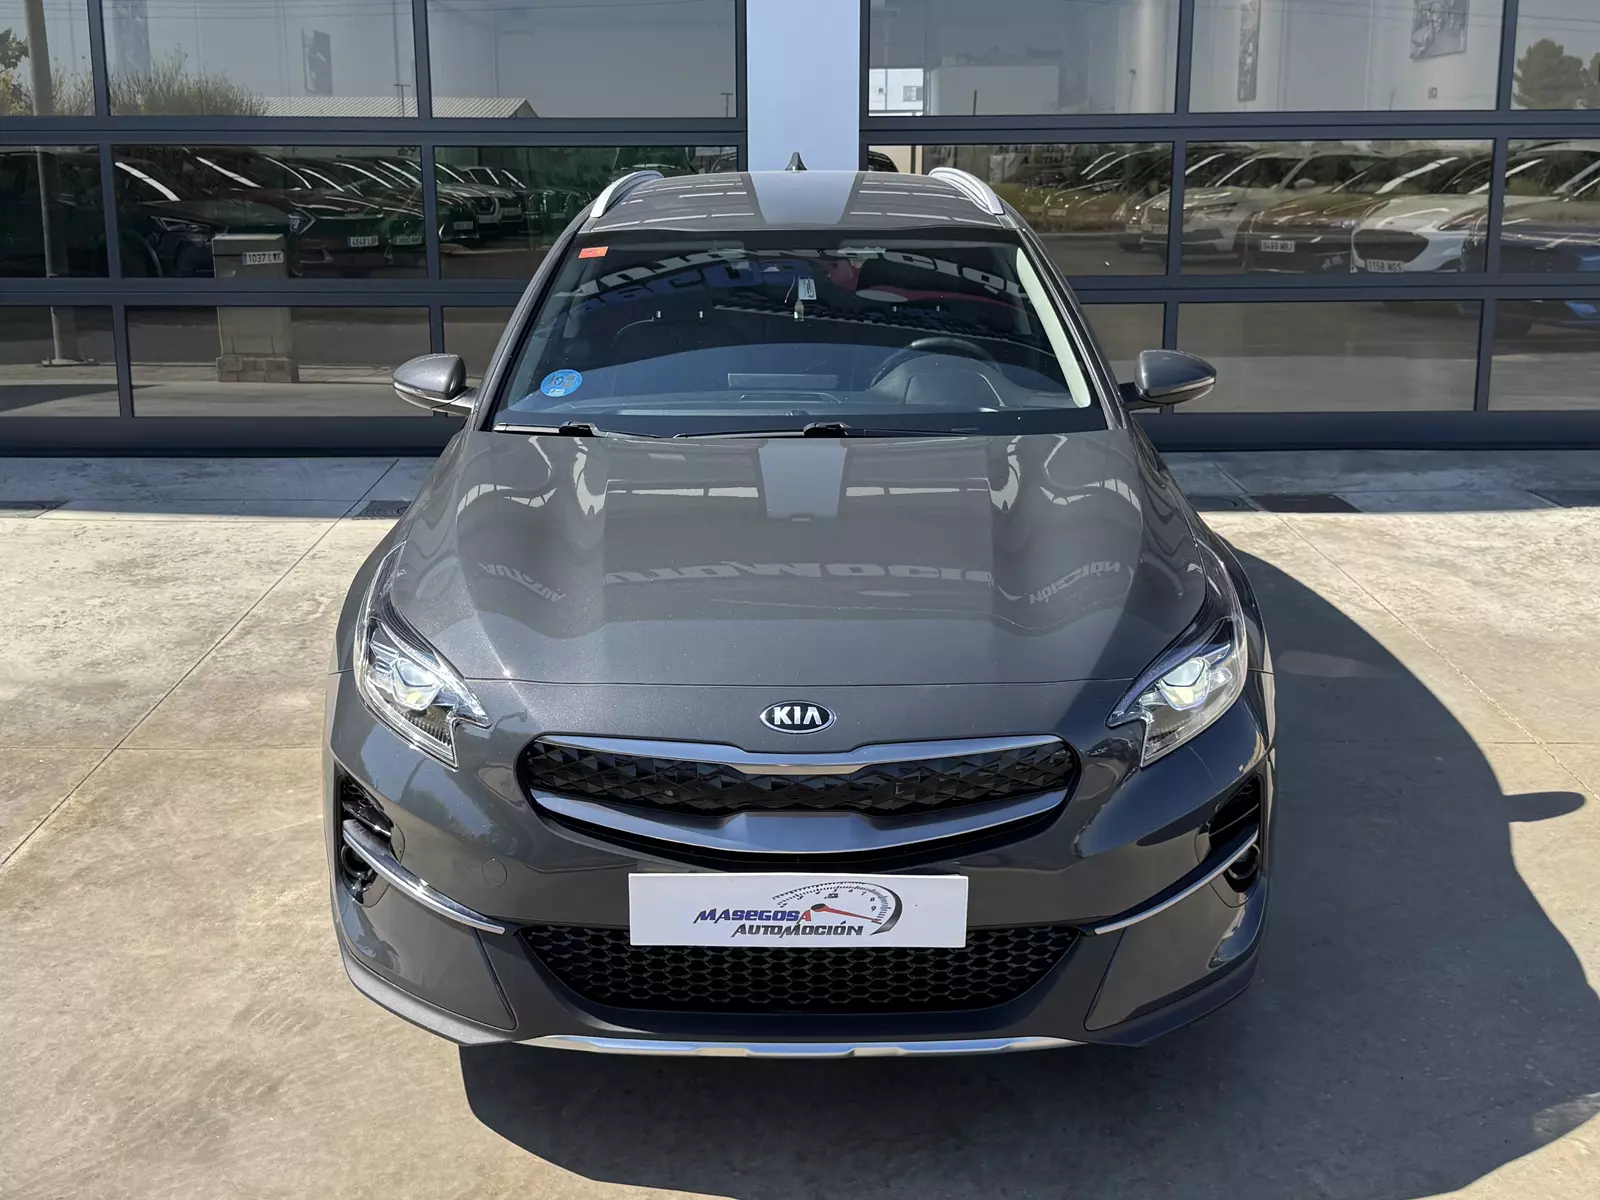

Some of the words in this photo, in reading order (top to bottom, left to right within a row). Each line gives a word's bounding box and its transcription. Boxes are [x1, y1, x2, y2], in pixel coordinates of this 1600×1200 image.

[248, 253, 266, 263] 1037
[773, 705, 822, 725] KIA
[731, 921, 864, 938] AUTOMOCIÓN
